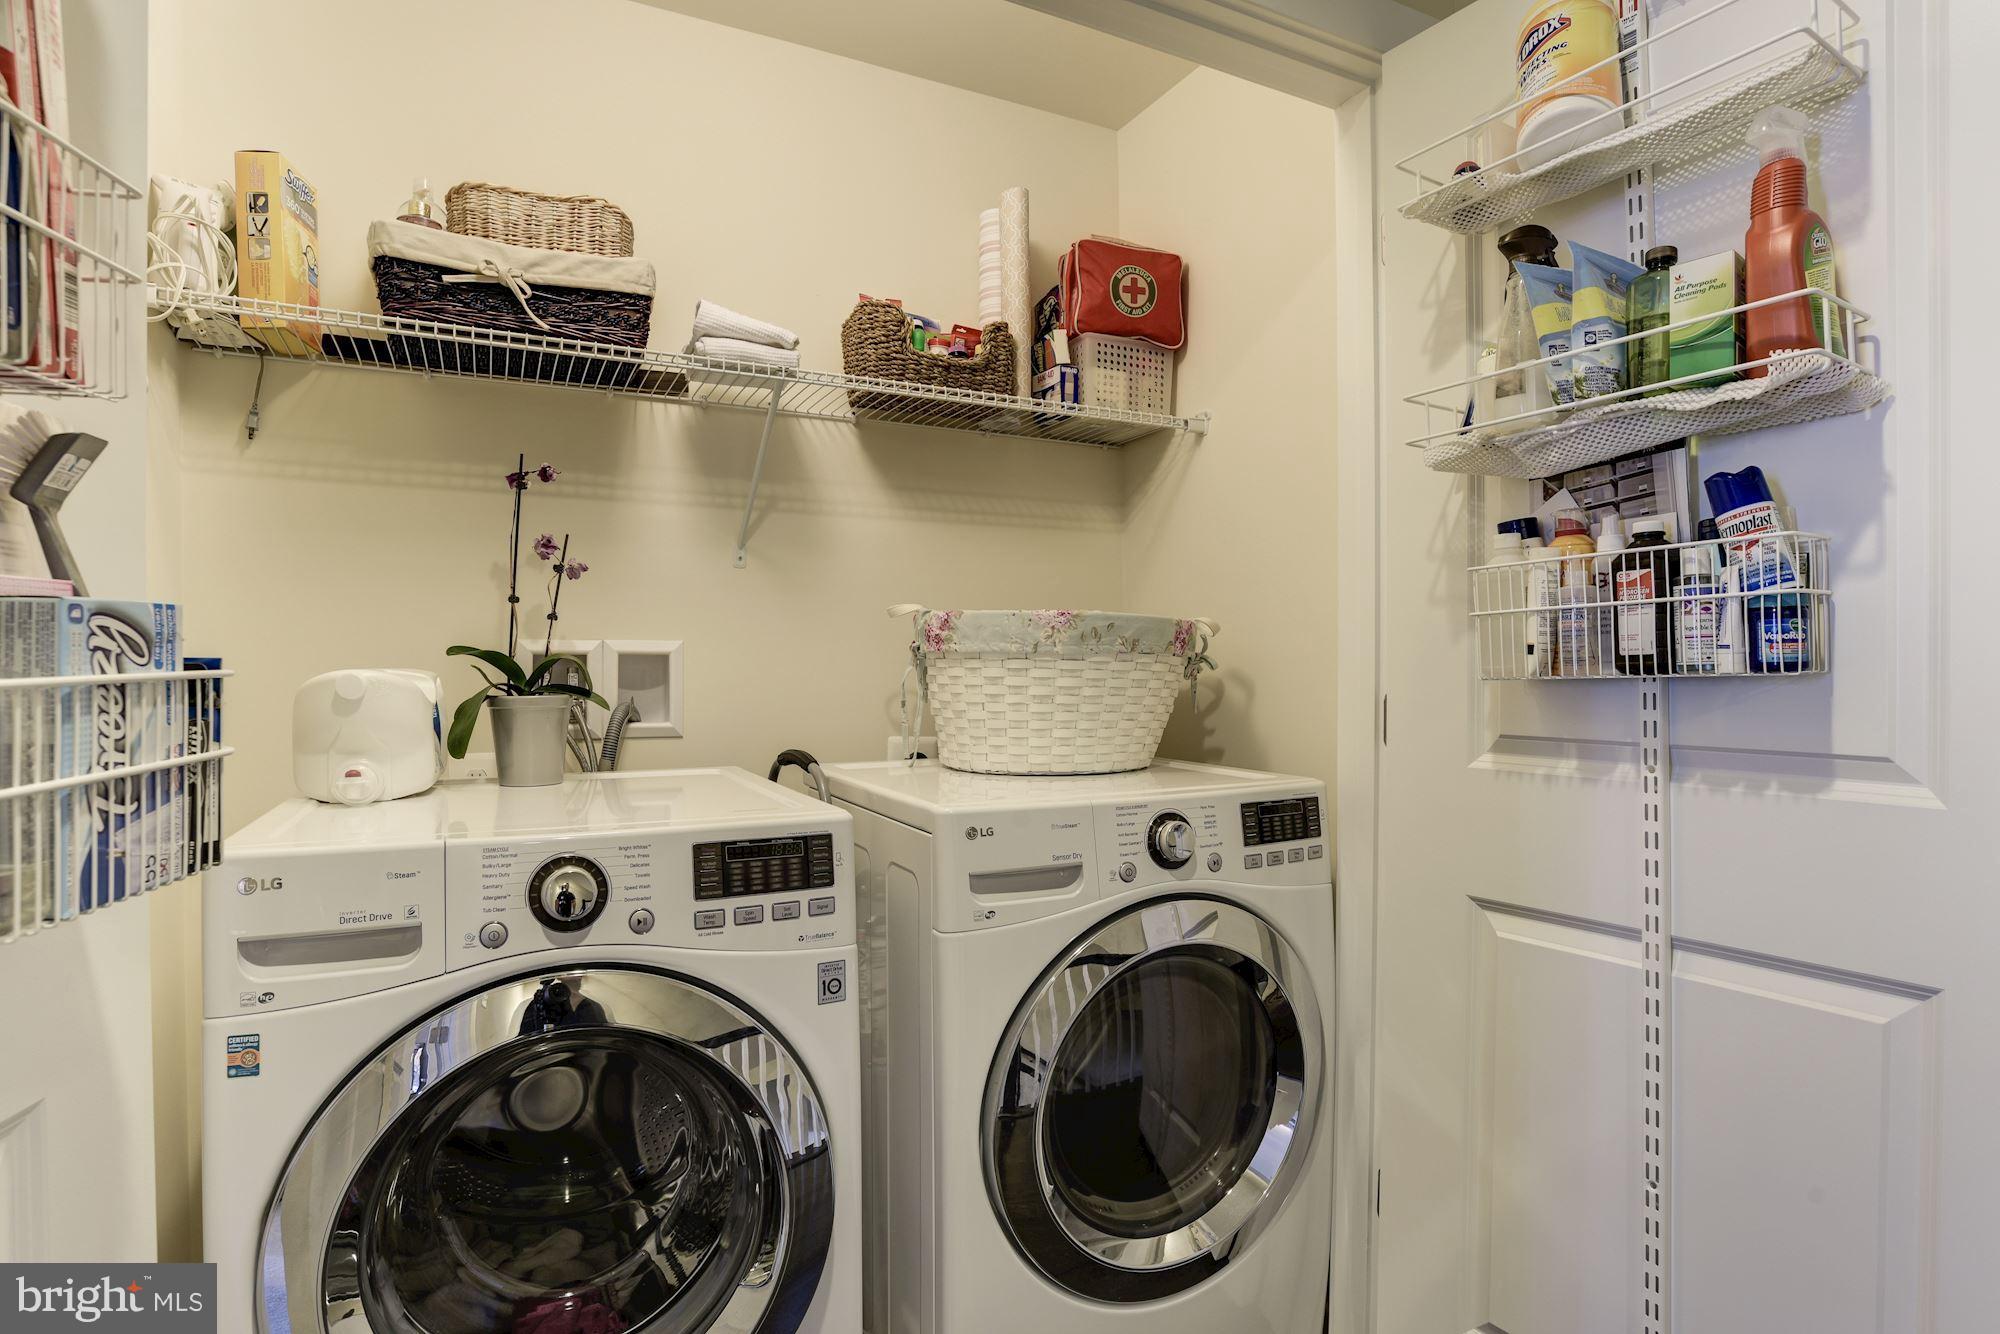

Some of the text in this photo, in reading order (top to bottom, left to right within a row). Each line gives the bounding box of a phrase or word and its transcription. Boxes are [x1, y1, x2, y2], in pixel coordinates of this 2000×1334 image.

[285, 168, 316, 204] Swiffer
[1115, 267, 1152, 283] MELALEUCA
[1674, 278, 1718, 293] All Purpose
[1674, 287, 1707, 300] Cleaning
[1708, 282, 1727, 291] Pads
[1116, 299, 1152, 316] FIRST AID KIT
[1720, 513, 1773, 538] ermoplast
[153, 608, 163, 633] linen
[153, 635, 163, 661] fresh
[980, 827, 994, 837] LG
[1072, 852, 1082, 860] Dry
[260, 878, 283, 891] LG
[339, 911, 393, 925] Direct Drive
[822, 978, 842, 996] 10
[229, 1035, 259, 1044] CERTIFIED
